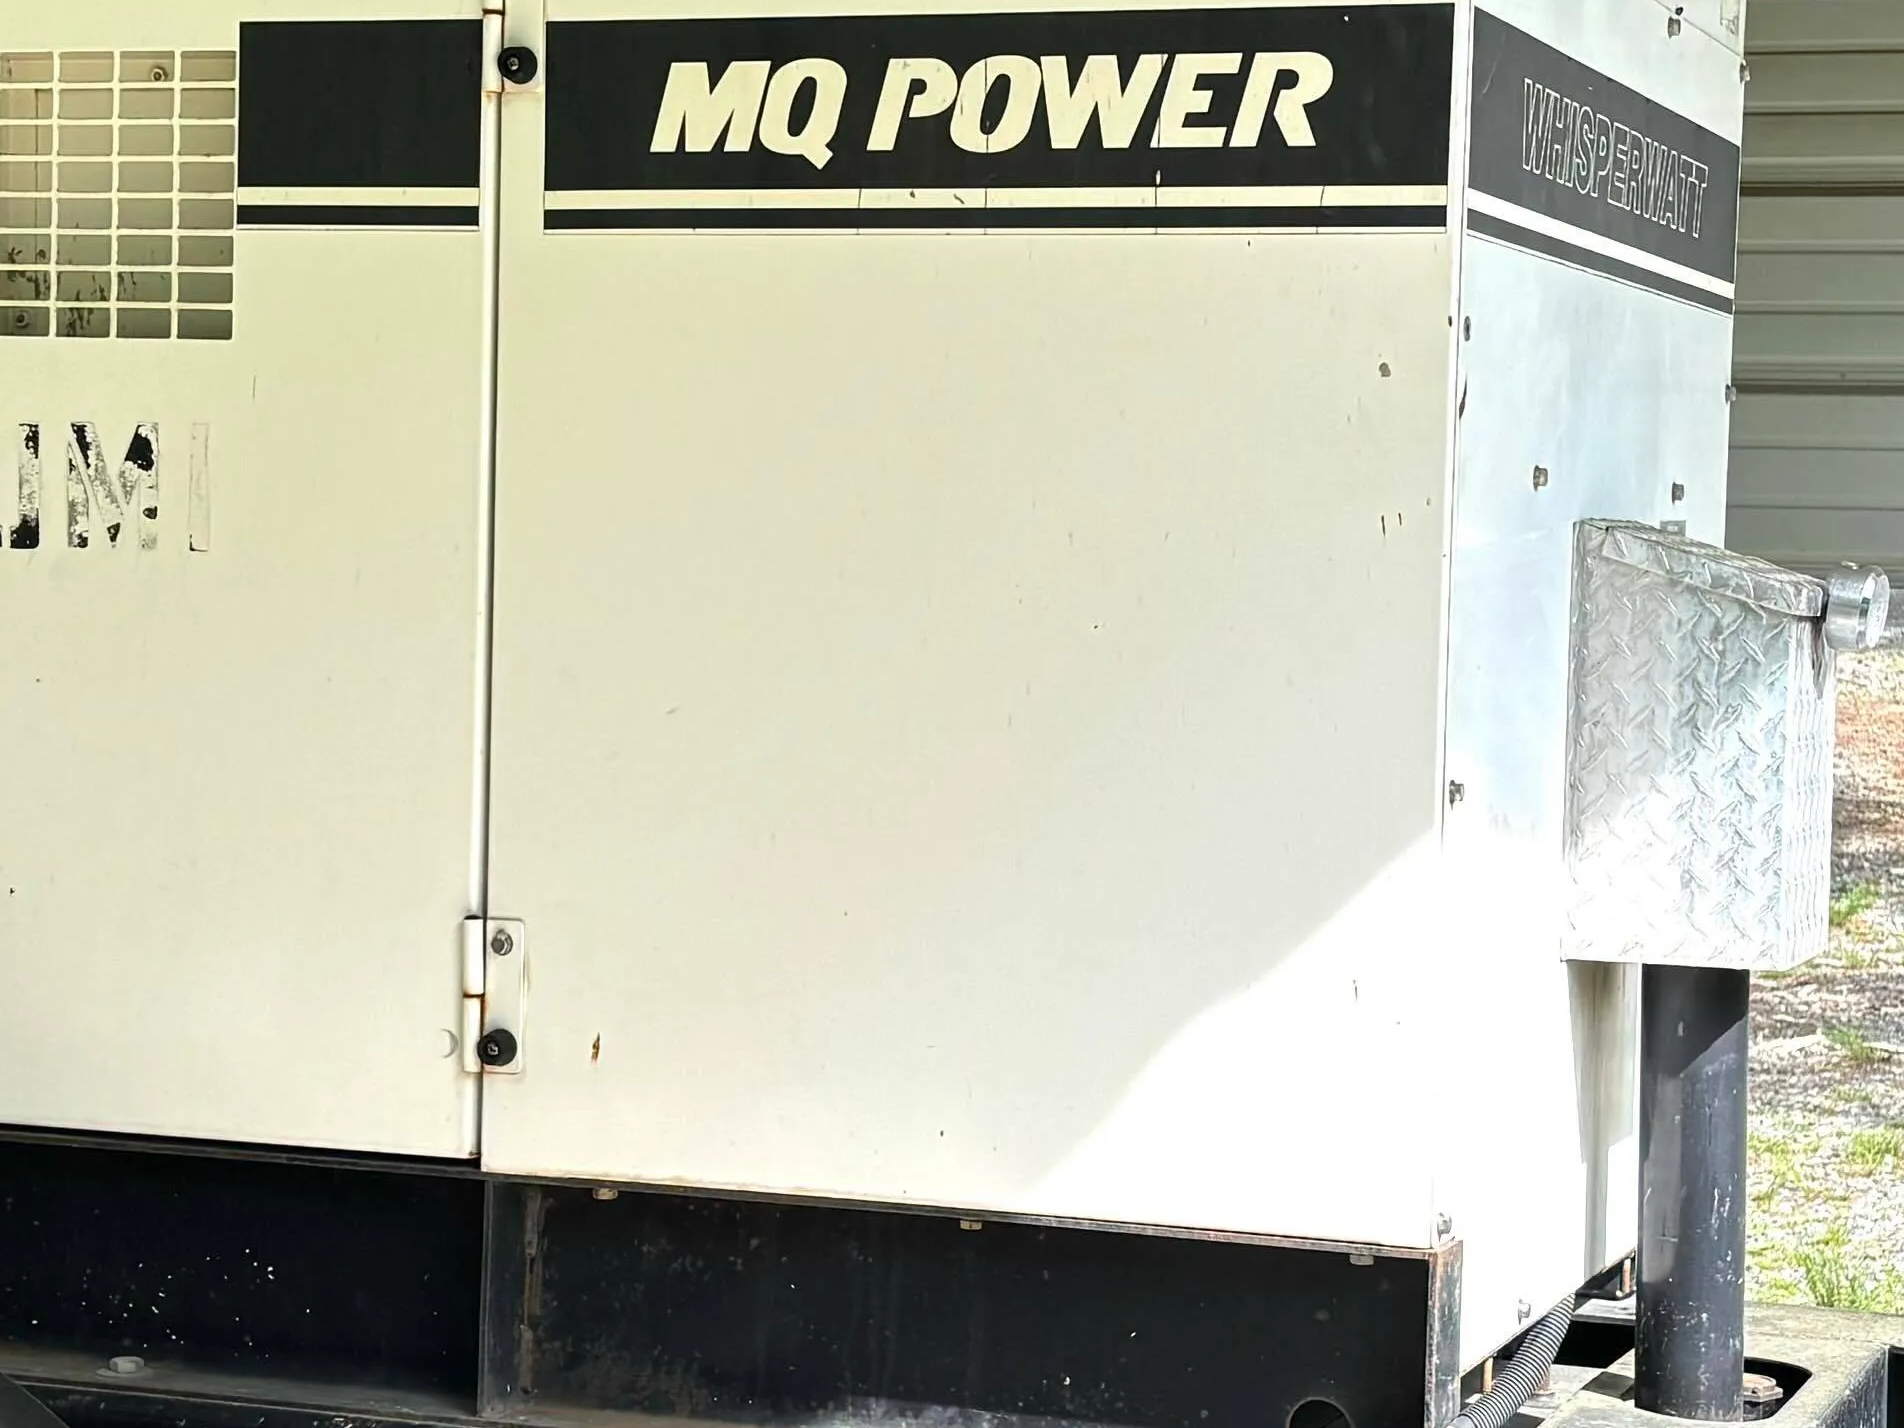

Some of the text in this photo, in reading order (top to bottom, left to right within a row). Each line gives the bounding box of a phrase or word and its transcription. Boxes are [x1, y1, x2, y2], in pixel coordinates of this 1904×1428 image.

[649, 50, 1335, 171] MQ POWER
[1522, 77, 1709, 239] WHISPERWATT
